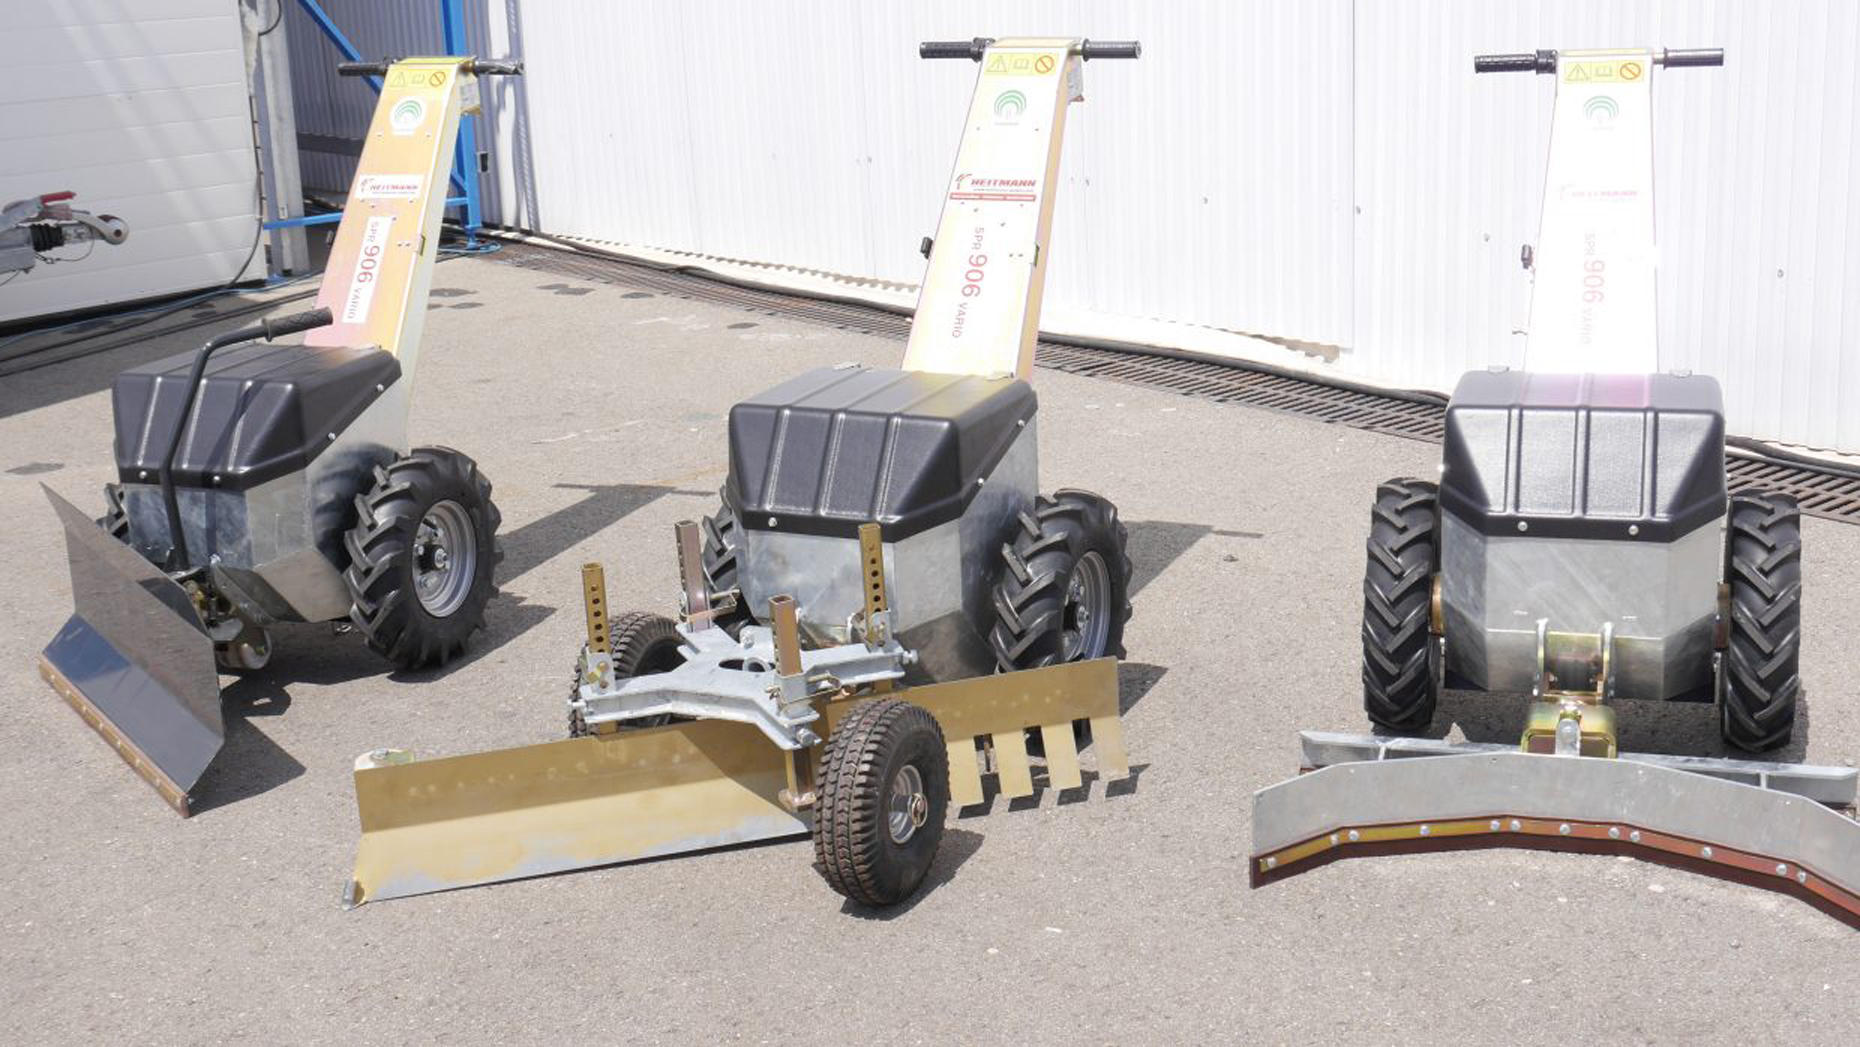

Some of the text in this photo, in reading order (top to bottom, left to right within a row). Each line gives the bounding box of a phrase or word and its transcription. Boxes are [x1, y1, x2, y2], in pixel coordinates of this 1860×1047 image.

[970, 179, 1037, 187] HEITMANN
[347, 221, 380, 319] SPR 906 VARIO
[952, 227, 988, 338] SPR 906 VARIO
[1583, 259, 1605, 303] 906
